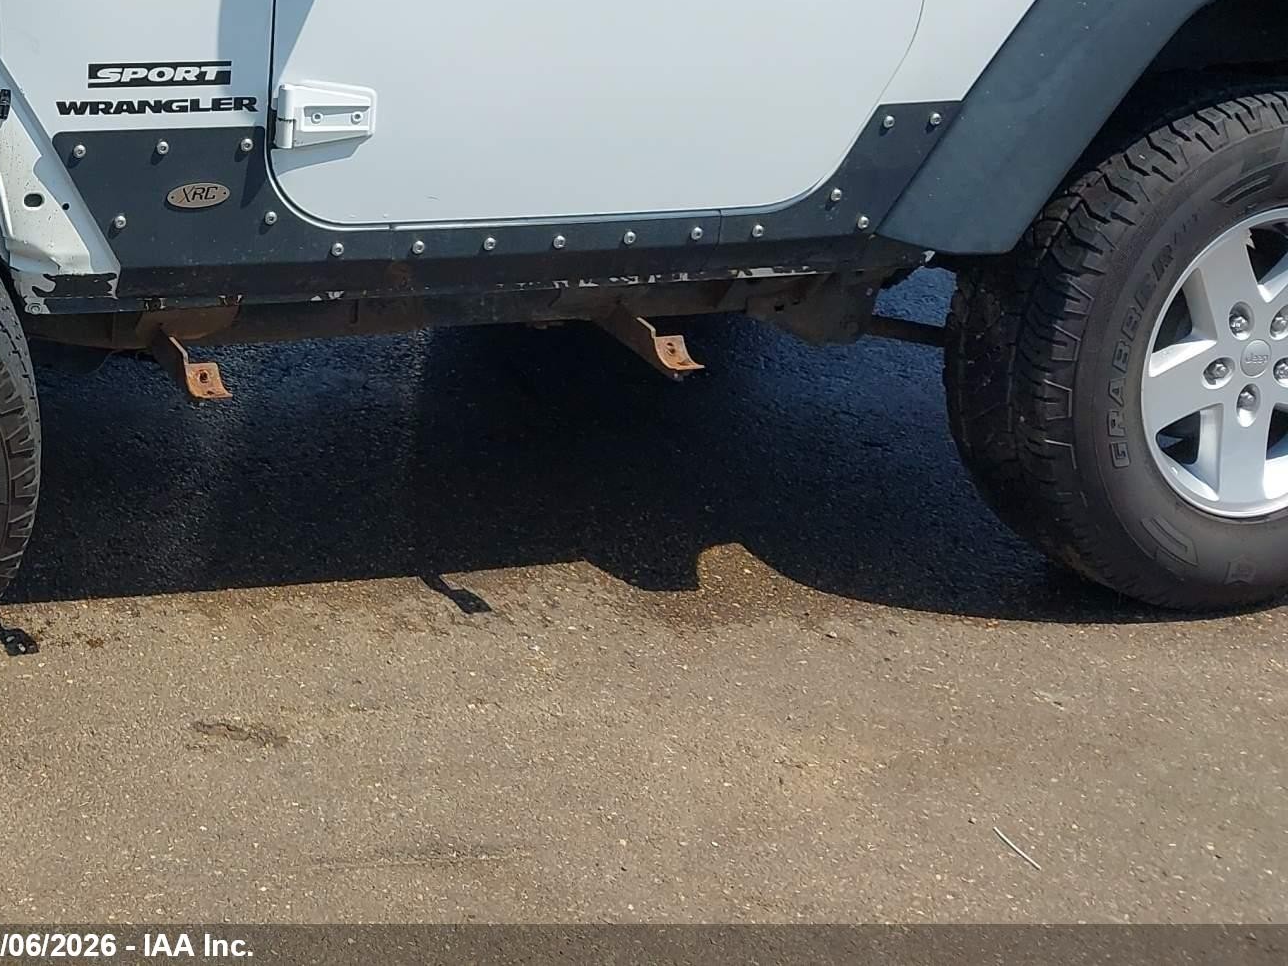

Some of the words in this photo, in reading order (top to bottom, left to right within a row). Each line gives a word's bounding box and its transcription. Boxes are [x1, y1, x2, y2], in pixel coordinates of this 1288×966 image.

[91, 64, 224, 85] SPORT
[55, 96, 259, 116] WRANGLER
[177, 186, 219, 203] XRC
